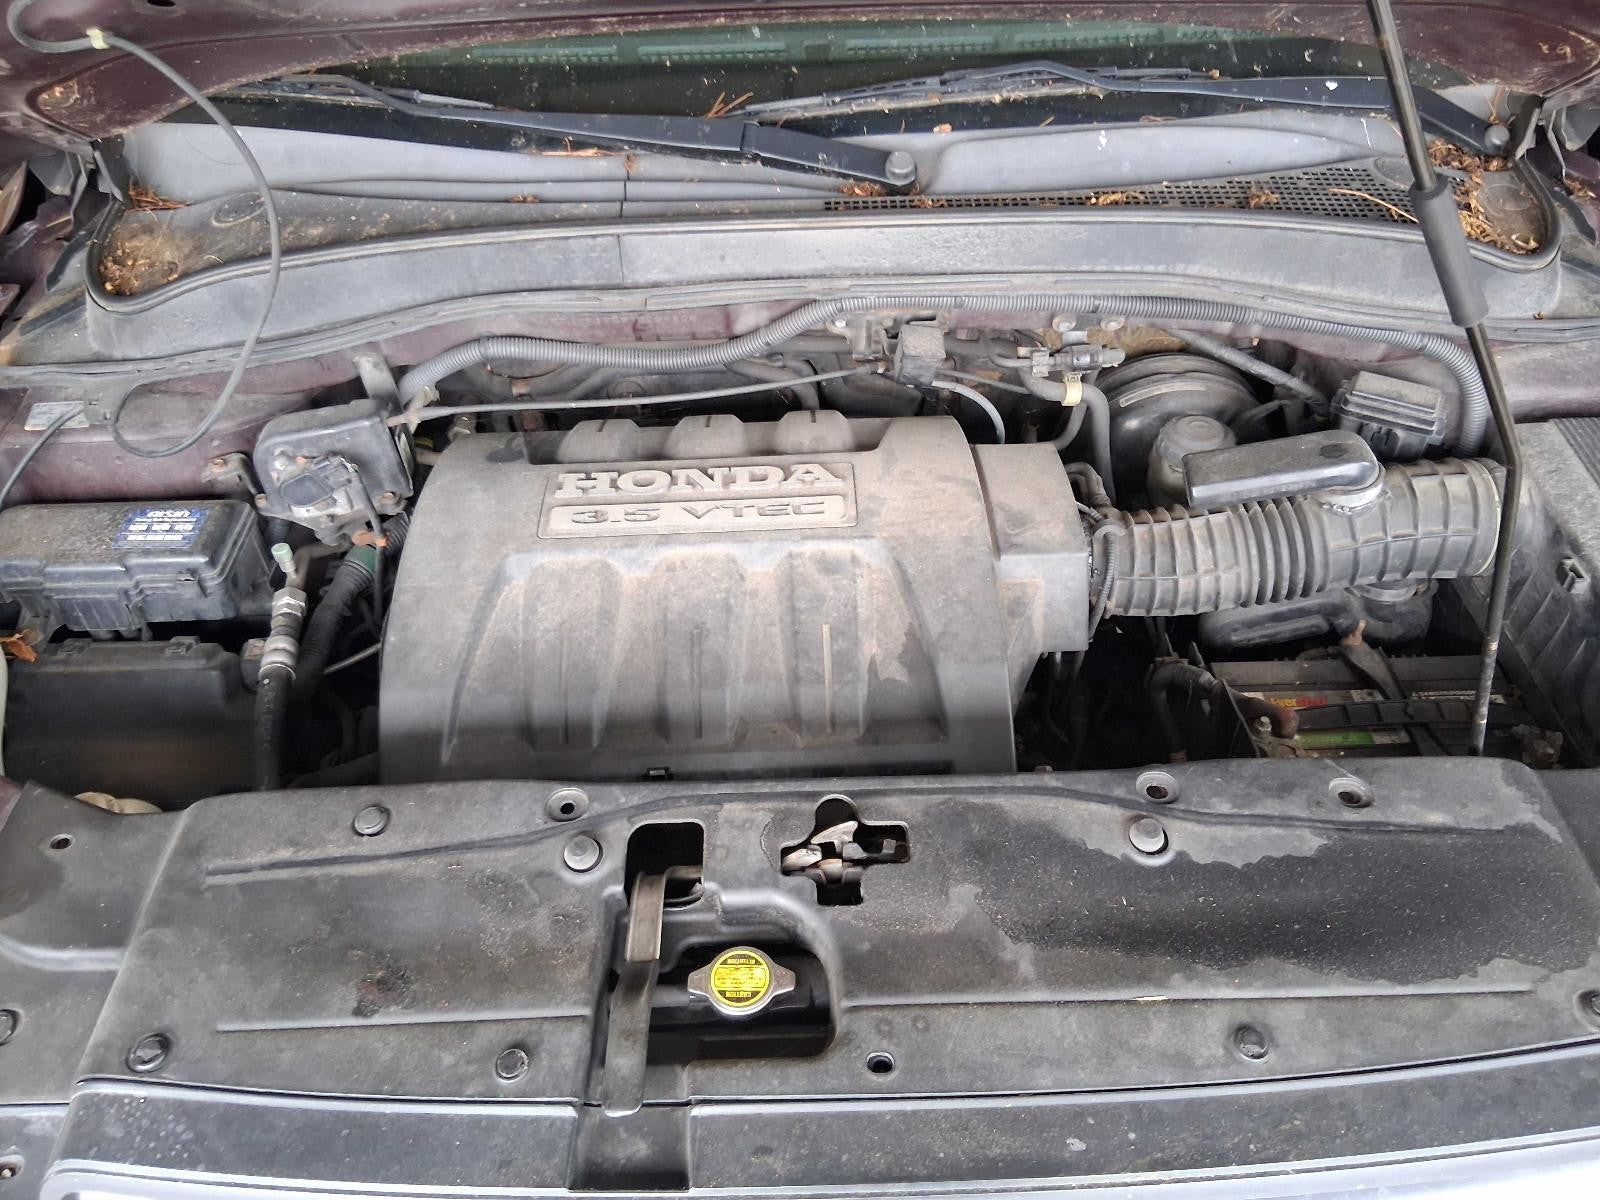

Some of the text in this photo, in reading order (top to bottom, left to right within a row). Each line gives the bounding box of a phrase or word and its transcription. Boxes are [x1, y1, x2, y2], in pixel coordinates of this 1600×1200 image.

[554, 463, 844, 498] HONDA
[570, 501, 826, 524] 3.5 VTEC
